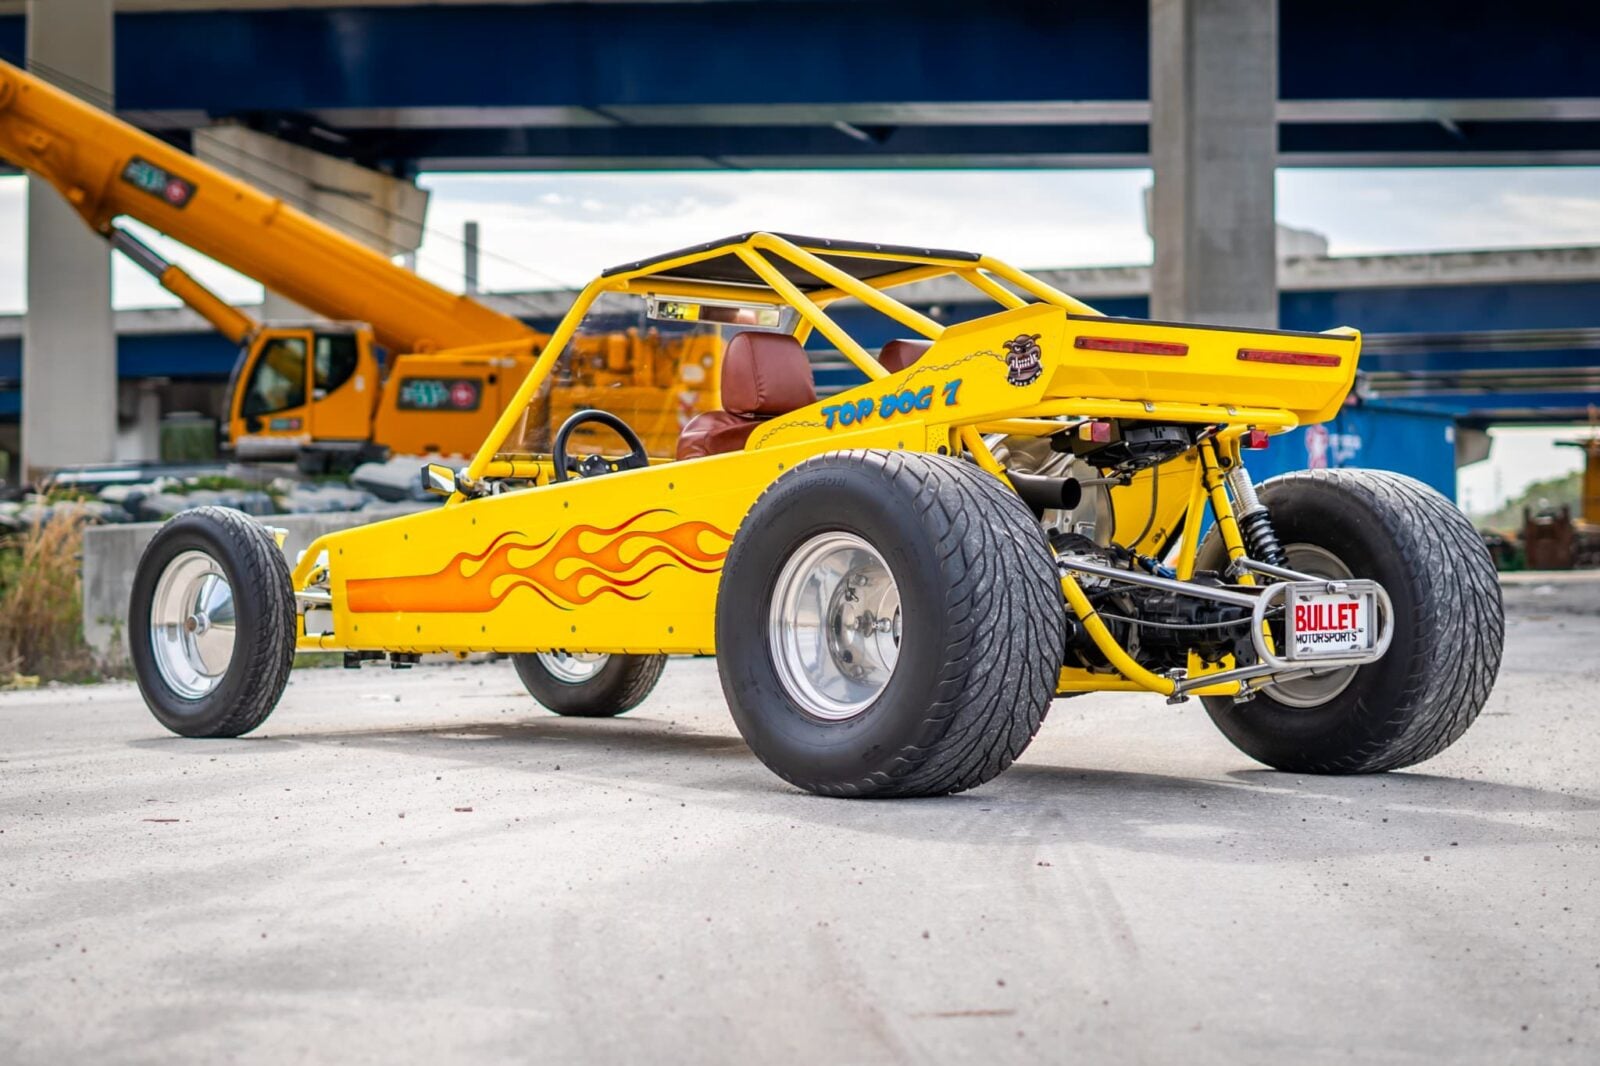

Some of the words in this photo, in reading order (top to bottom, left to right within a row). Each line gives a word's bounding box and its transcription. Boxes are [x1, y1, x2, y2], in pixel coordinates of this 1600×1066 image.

[821, 397, 875, 430] TOP
[878, 385, 934, 418] DOG
[1295, 603, 1358, 631] BULLET
[1295, 631, 1357, 644] MOTORSPORTS
